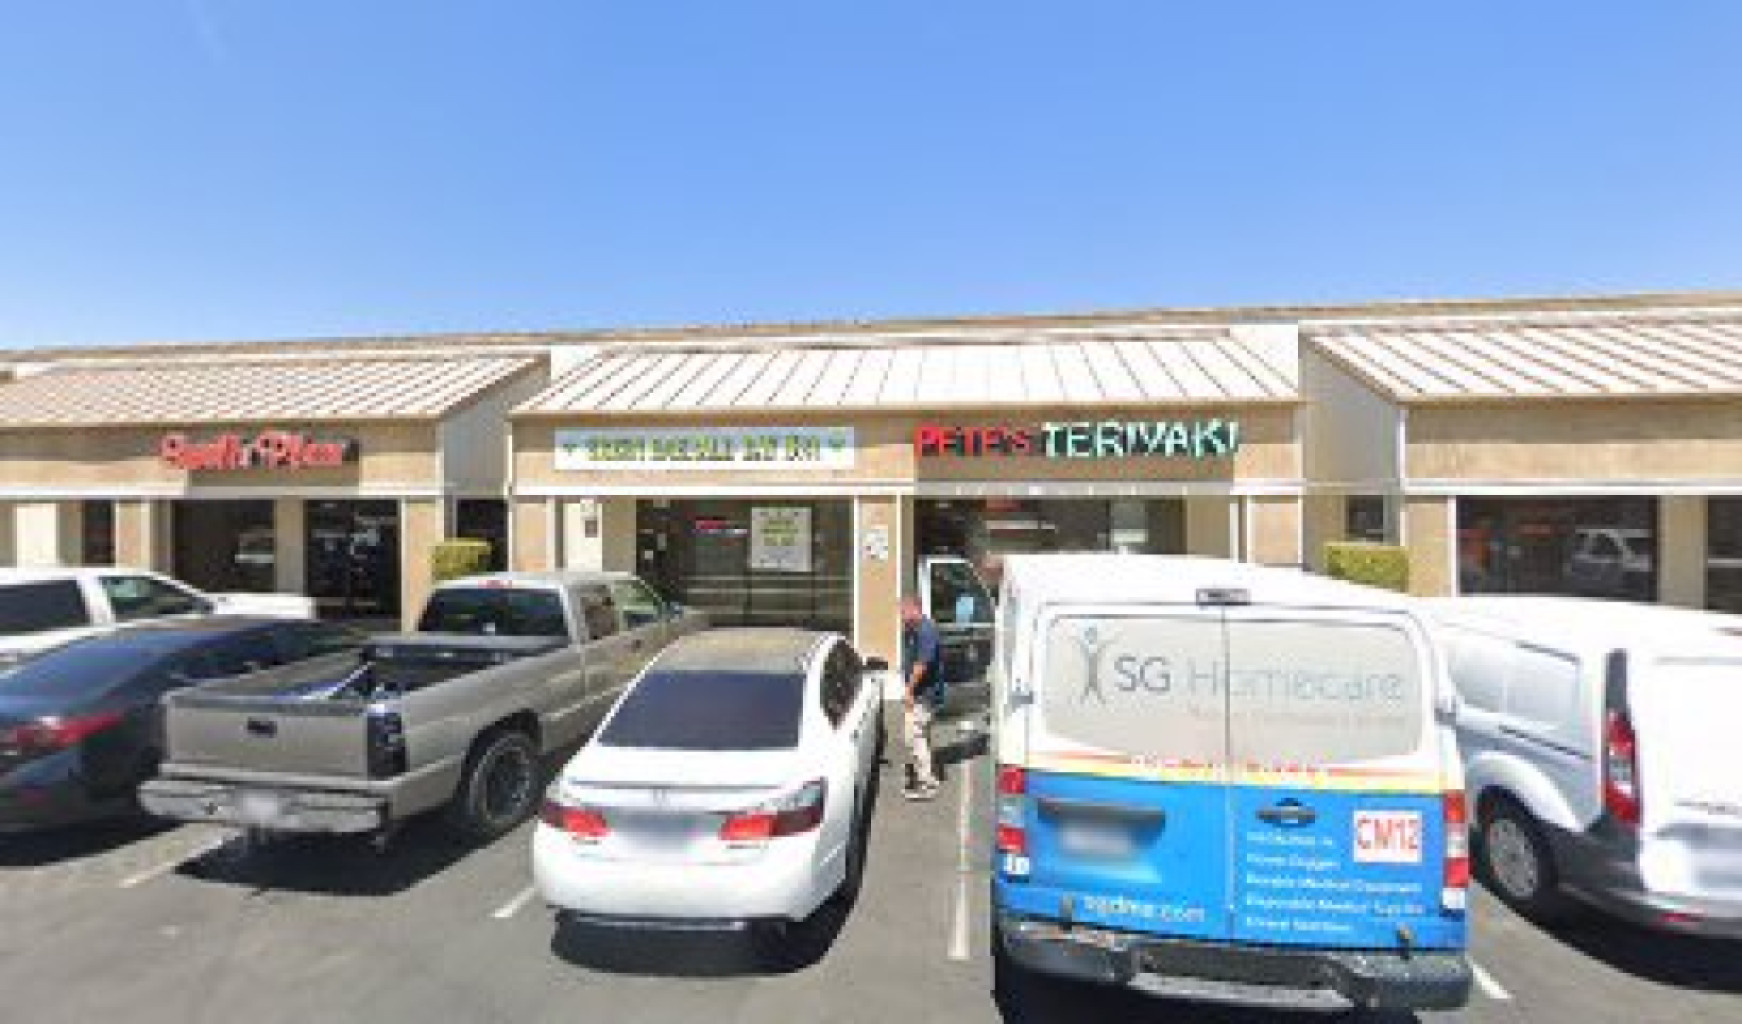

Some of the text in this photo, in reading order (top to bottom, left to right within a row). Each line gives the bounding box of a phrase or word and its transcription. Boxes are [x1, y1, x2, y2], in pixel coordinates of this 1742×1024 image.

[916, 420, 1240, 458] PETE'S TERIYAKI
[1114, 655, 1406, 702] SG Homecare
[1356, 815, 1419, 850] CM12
